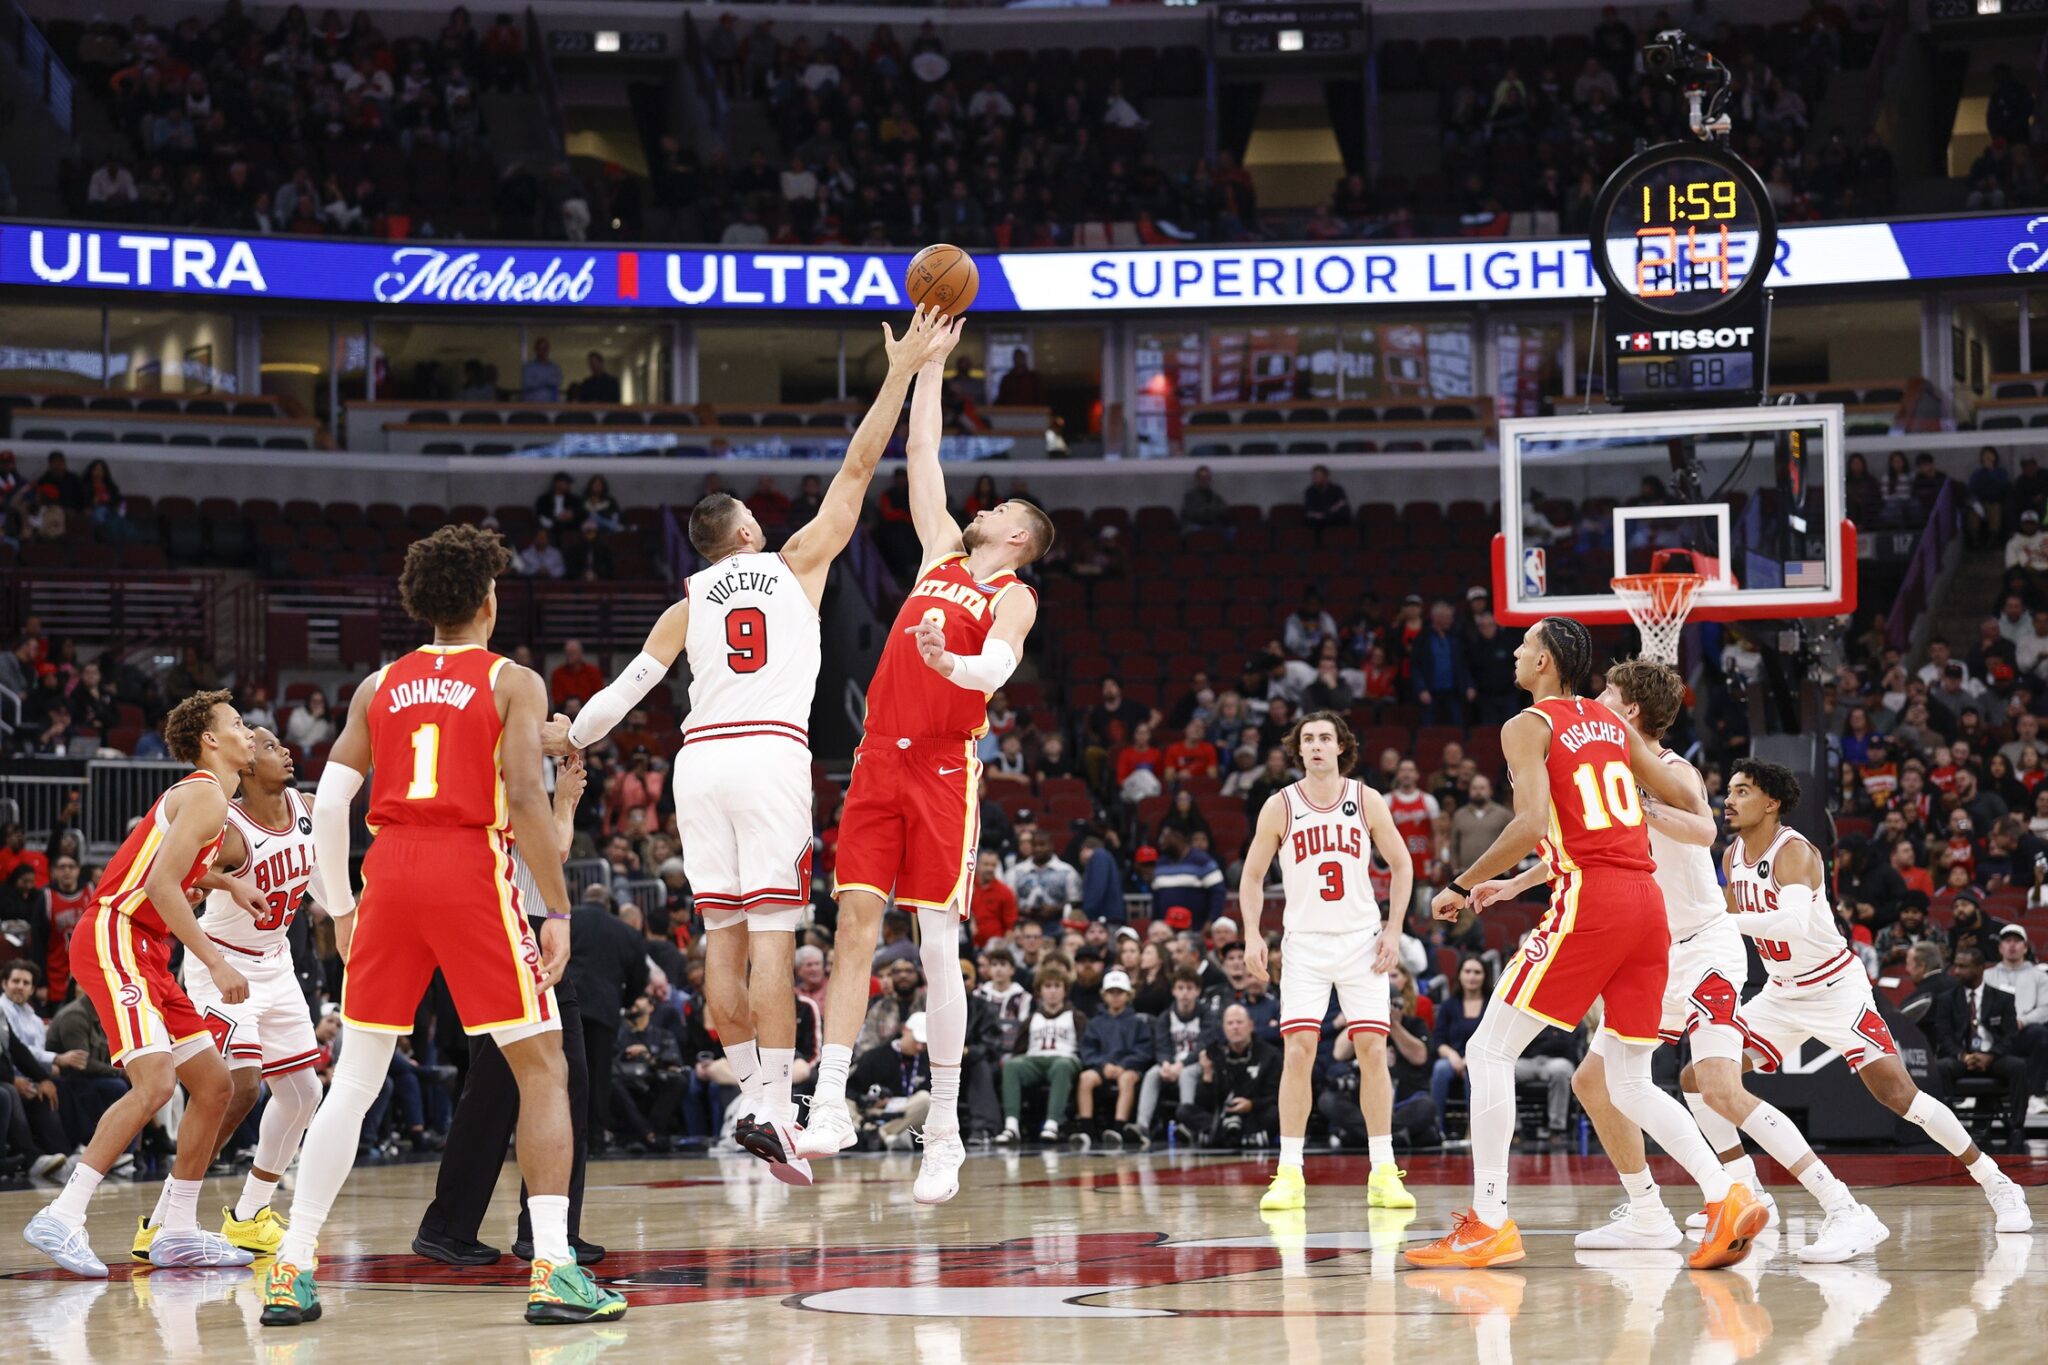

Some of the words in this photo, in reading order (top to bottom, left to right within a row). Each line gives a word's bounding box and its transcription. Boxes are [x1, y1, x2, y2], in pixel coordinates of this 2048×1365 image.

[1642, 181, 1737, 224] 11:59
[29, 230, 268, 291] ULTRA
[373, 247, 597, 304] Michelob
[666, 253, 900, 305] ULTRA
[1091, 254, 1397, 299] SUPERIOR
[1427, 248, 1595, 293] LIGHT
[1636, 223, 1729, 298] 24
[1653, 327, 1754, 350] TISSOT
[706, 572, 779, 605] VUČEVIĆ
[910, 579, 988, 622] ATLANTA
[725, 606, 768, 674] 9
[388, 678, 477, 714] JOHNSON
[1559, 720, 1626, 753] RISACHER
[406, 722, 440, 800] 1
[1573, 760, 1644, 831] 10
[1292, 824, 1361, 865] BULLS
[254, 844, 317, 894] BULL
[1318, 860, 1345, 902] 3
[1731, 880, 1779, 913] ULLS
